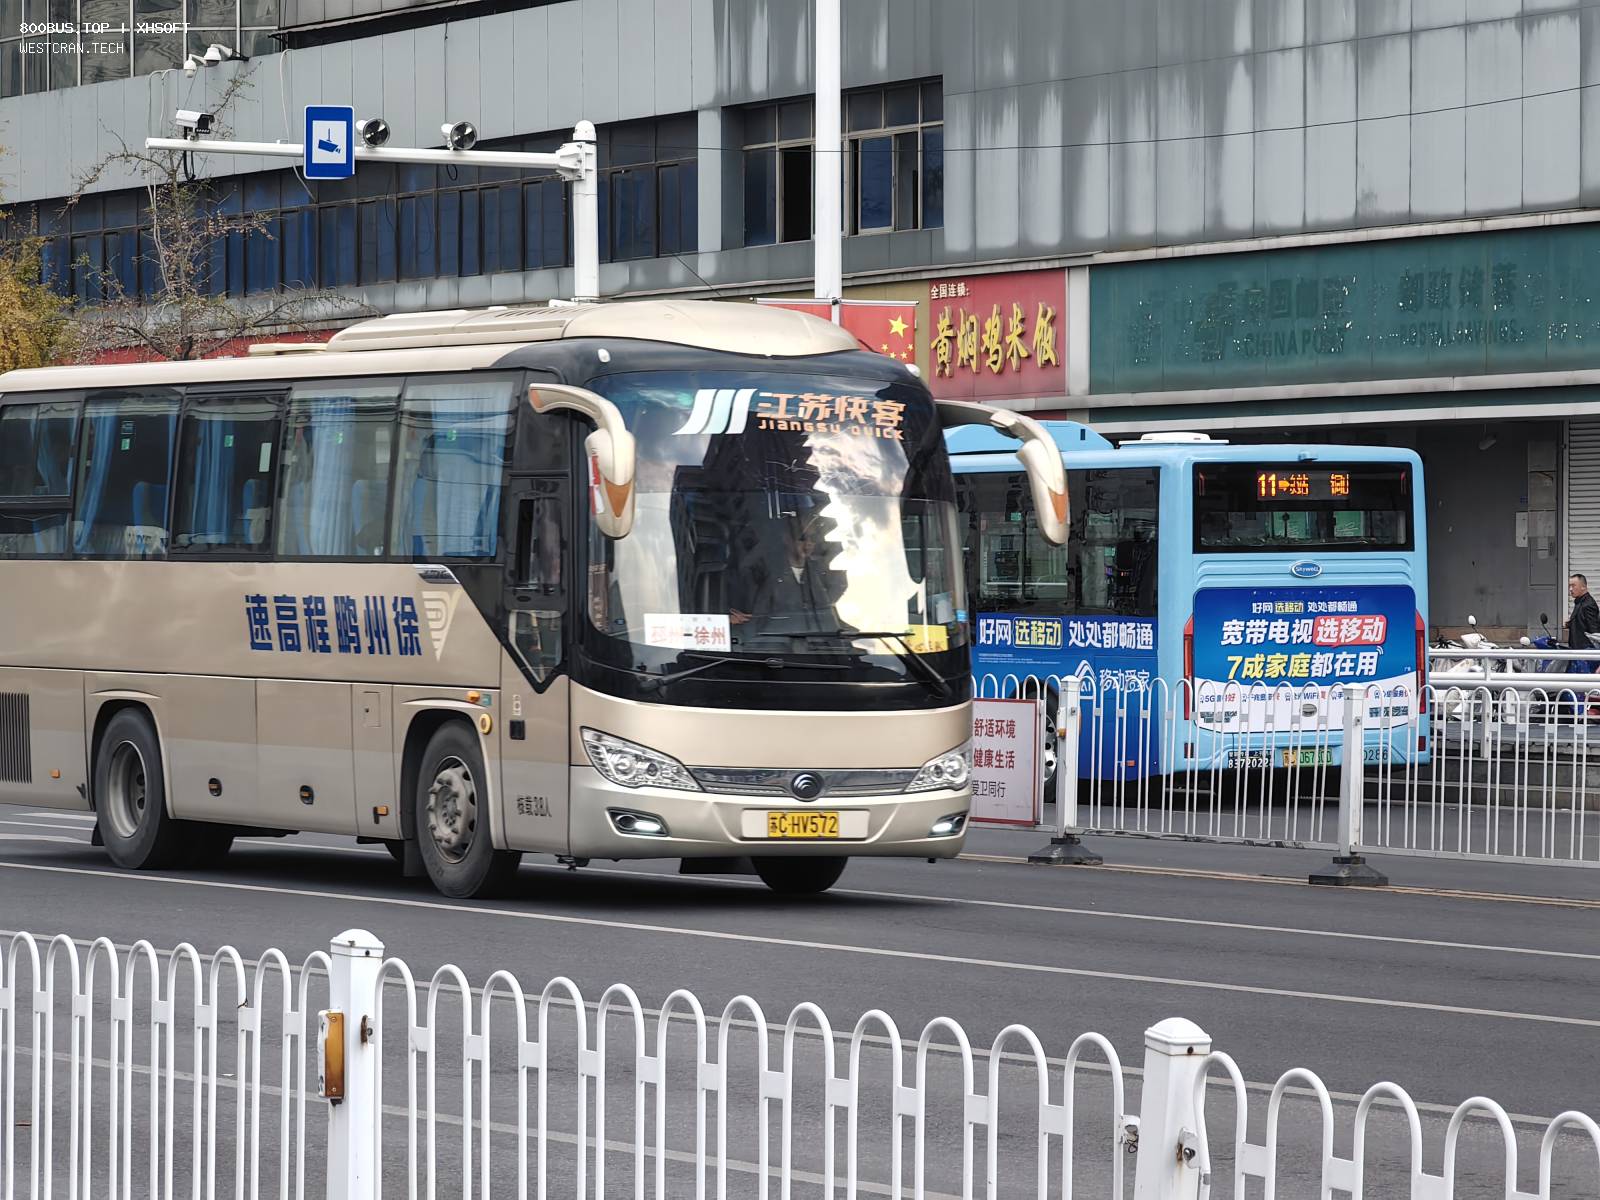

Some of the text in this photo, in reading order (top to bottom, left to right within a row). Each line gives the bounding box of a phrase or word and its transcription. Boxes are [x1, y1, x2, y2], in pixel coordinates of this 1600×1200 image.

[931, 302, 1060, 377] 黄焖鸡米饭
[757, 392, 906, 427] 江苏快客
[1252, 602, 1273, 614] 好网
[1275, 602, 1304, 613] 选移动
[979, 619, 1153, 650] 好网 选移动 处处都畅通
[1220, 617, 1385, 646] 宽带电视 选移动
[1227, 652, 1378, 680] 7成家庭都在用
[974, 718, 1016, 738] 舒适环境
[974, 748, 1015, 769] 健康生活
